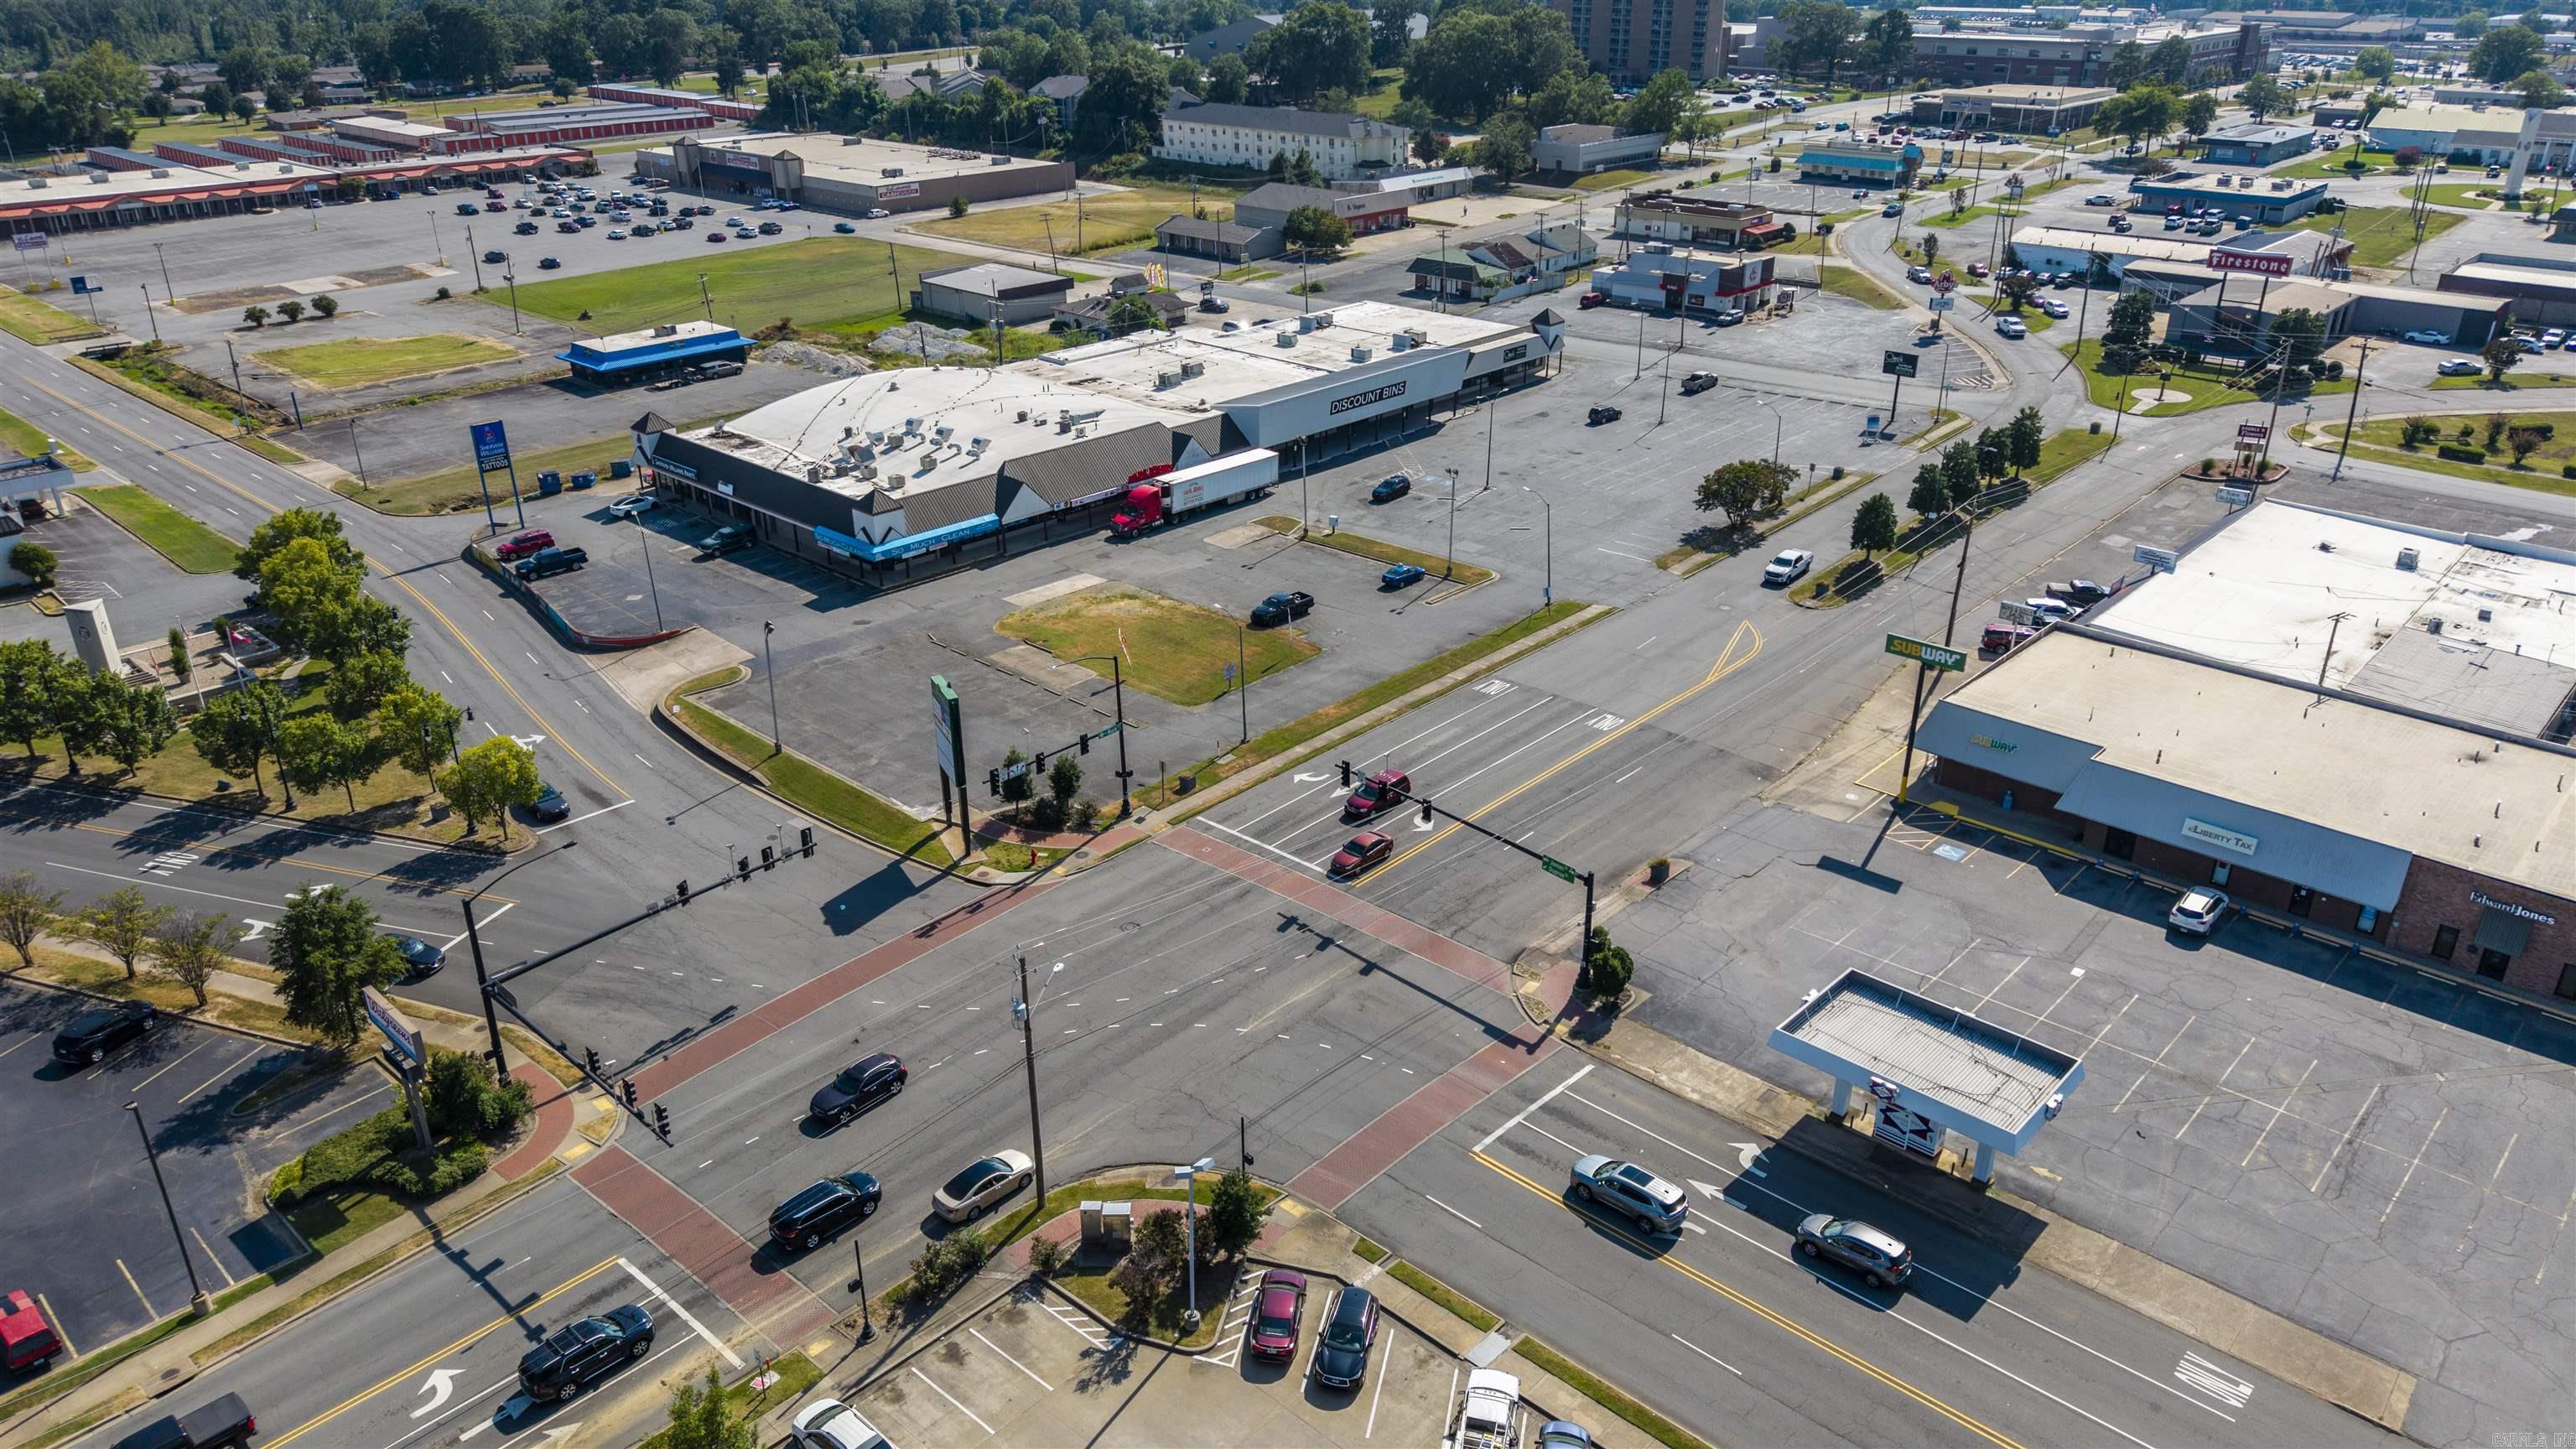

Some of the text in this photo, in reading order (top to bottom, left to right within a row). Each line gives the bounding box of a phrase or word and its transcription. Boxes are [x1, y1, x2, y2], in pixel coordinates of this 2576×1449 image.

[2210, 252, 2288, 273] Firestone
[1331, 383, 1405, 413] DISCOUNT BINS
[482, 459, 509, 470] TATTOOS
[910, 538, 935, 550] MUCH
[941, 529, 970, 542] CLEAN
[1890, 638, 1961, 666] SUBWAY
[1472, 678, 1511, 695] ONLY
[1584, 713, 1625, 731] ONLY
[1971, 732, 2019, 754] SUBWAY
[138, 851, 200, 877] ONLY
[2470, 891, 2557, 926] Edward Jones
[369, 999, 413, 1047] Walgreens
[2174, 1350, 2255, 1409] ONLY
